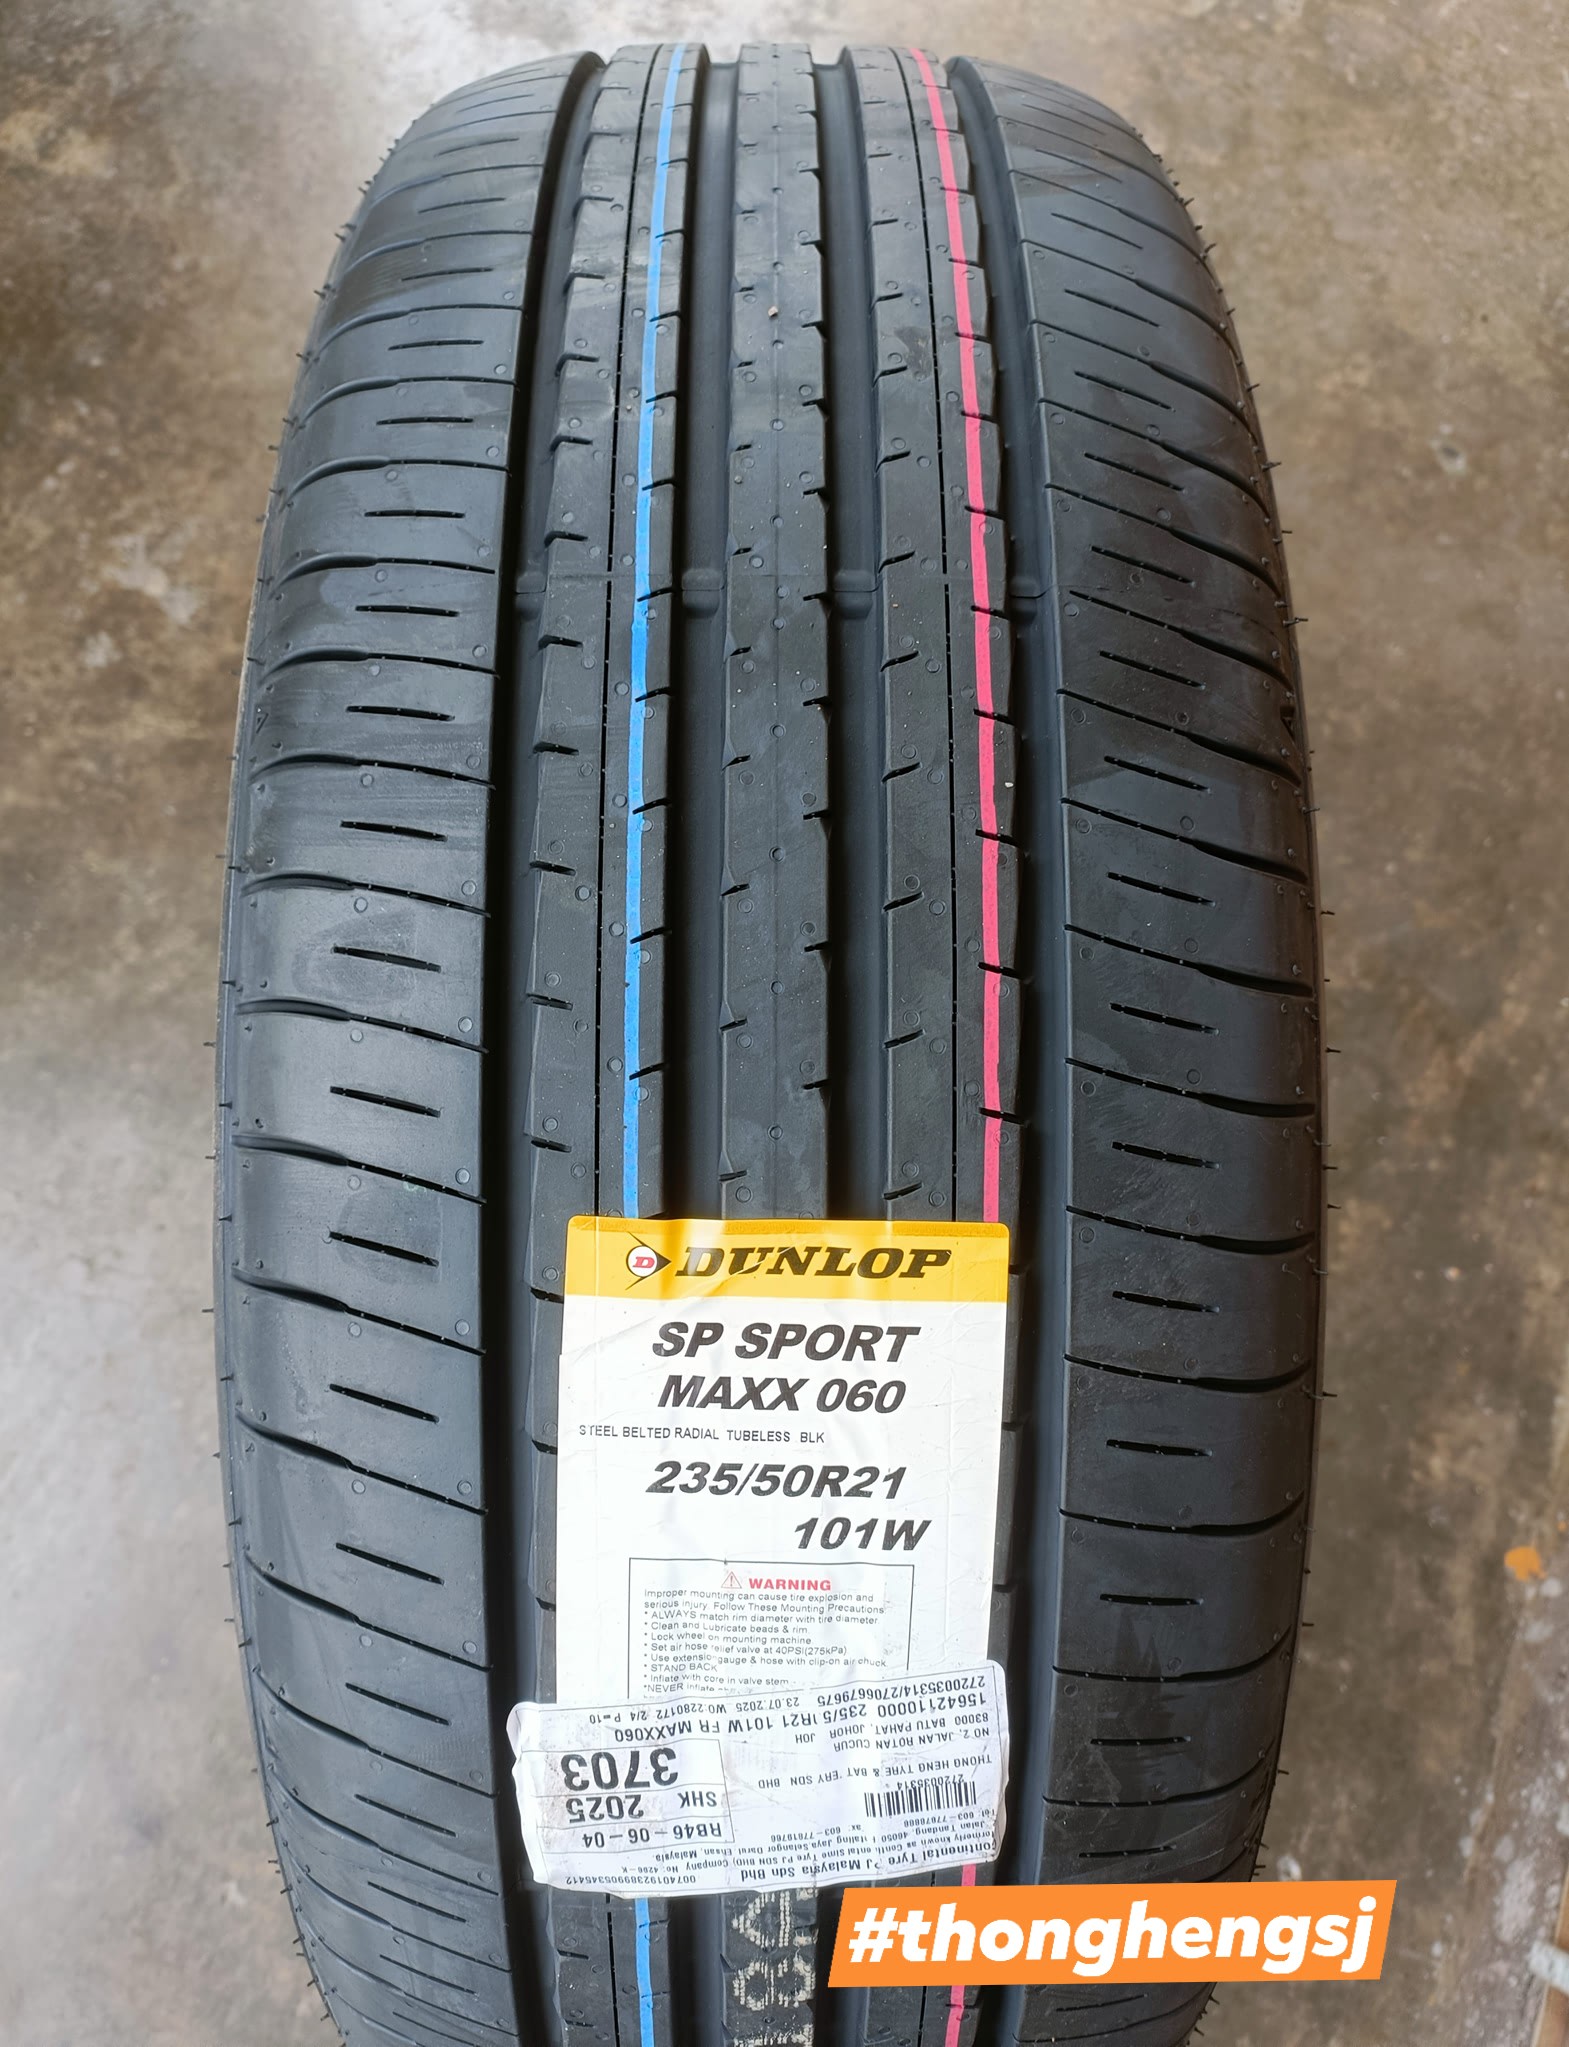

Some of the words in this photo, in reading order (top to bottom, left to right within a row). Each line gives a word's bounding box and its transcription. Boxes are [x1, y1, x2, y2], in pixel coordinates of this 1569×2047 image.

[675, 1246, 952, 1279] DUNLOP
[652, 1321, 724, 1358] SP
[734, 1323, 921, 1363] SPORT
[658, 1375, 808, 1412] MAXX
[816, 1379, 907, 1414] 060
[579, 1425, 618, 1437] STEEL
[622, 1426, 671, 1439] BELTED
[674, 1427, 719, 1440] RADIAL
[726, 1429, 790, 1442] TUBELESS
[800, 1431, 825, 1444] BLK
[646, 1461, 907, 1500] 235/50R21
[794, 1517, 932, 1551] 101W
[749, 1578, 831, 1591] WARNING
[644, 1589, 687, 1598] Improper
[690, 1590, 735, 1601] mounting
[790, 1593, 805, 1602] tire
[808, 1593, 853, 1604] explosion
[856, 1593, 874, 1602] and
[644, 1600, 679, 1608] serious
[713, 1602, 745, 1611] Follow
[748, 1603, 777, 1612] These
[781, 1604, 825, 1614] Mounting
[651, 1610, 697, 1619] ALWAYS
[699, 1613, 729, 1621] match
[750, 1614, 793, 1623] diameter
[795, 1615, 815, 1623] with
[818, 1615, 833, 1623] tire
[651, 1621, 679, 1630] Clean
[682, 1621, 700, 1629] and
[703, 1622, 747, 1632] Lubricate
[750, 1624, 779, 1633] beads
[782, 1625, 789, 1633] &
[651, 1632, 674, 1641] Lock
[677, 1631, 705, 1640] wheel
[723, 1635, 767, 1645] mounting
[651, 1643, 667, 1652] Set
[670, 1643, 682, 1651] air
[685, 1642, 708, 1650] hose
[711, 1644, 734, 1653] relief
[775, 1646, 847, 1656] 40PSI(275kPa)
[651, 1653, 670, 1662] Use
[718, 1657, 747, 1665] gauge
[750, 1656, 757, 1664] &
[786, 1657, 806, 1665] with
[809, 1658, 840, 1667] clip-on
[650, 1663, 686, 1672] STAND
[689, 1663, 718, 1672] BACK
[650, 1674, 679, 1682] Inflate
[682, 1673, 700, 1681] with
[704, 1675, 724, 1683] core
[727, 1676, 736, 1684] in
[738, 1677, 762, 1685] valve
[817, 1676, 985, 1707] 2720035314/2706679675
[736, 1697, 799, 1712] 23.07.2025
[878, 1692, 986, 1718] 15642110000
[630, 1710, 647, 1720] 2/4
[954, 1712, 988, 1725] 83000
[699, 1720, 720, 1733] FR
[728, 1716, 772, 1733] 101W
[870, 1722, 911, 1734] PAHAT,
[917, 1718, 945, 1730] BATU
[614, 1720, 692, 1742] MAXX060
[829, 1724, 864, 1738] JOHOR
[974, 1727, 989, 1737] NO
[795, 1733, 815, 1744] JOH
[876, 1737, 913, 1749] ROTAN
[918, 1732, 954, 1744] JALAN
[834, 1739, 870, 1752] CUCUR
[918, 1760, 949, 1772] HENG
[954, 1754, 991, 1767] THONG
[561, 1748, 678, 1791] 3703
[818, 1768, 867, 1784] BATERY
[873, 1768, 880, 1777] &
[885, 1765, 913, 1776] TYRE
[758, 1778, 780, 1788] BHD
[790, 1776, 812, 1786] SDN
[897, 1774, 964, 1790] 2720035314
[677, 1791, 717, 1808] SHK
[566, 1794, 644, 1823] 2025
[960, 1820, 985, 1830] Jalan
[881, 1832, 908, 1842] 46050
[920, 1836, 950, 1845] known
[738, 1847, 762, 1855] Darul
[797, 1852, 817, 1862] Tyre
[822, 1849, 844, 1858] Sime
[686, 1859, 728, 1871] Company
[759, 1857, 777, 1865] SDN
[782, 1856, 792, 1864] PJ
[888, 1852, 916, 1865] Tyre
[772, 1867, 794, 1878] Sdn
[802, 1859, 860, 1876] Malaysia
[740, 1869, 765, 1882] Bhd
